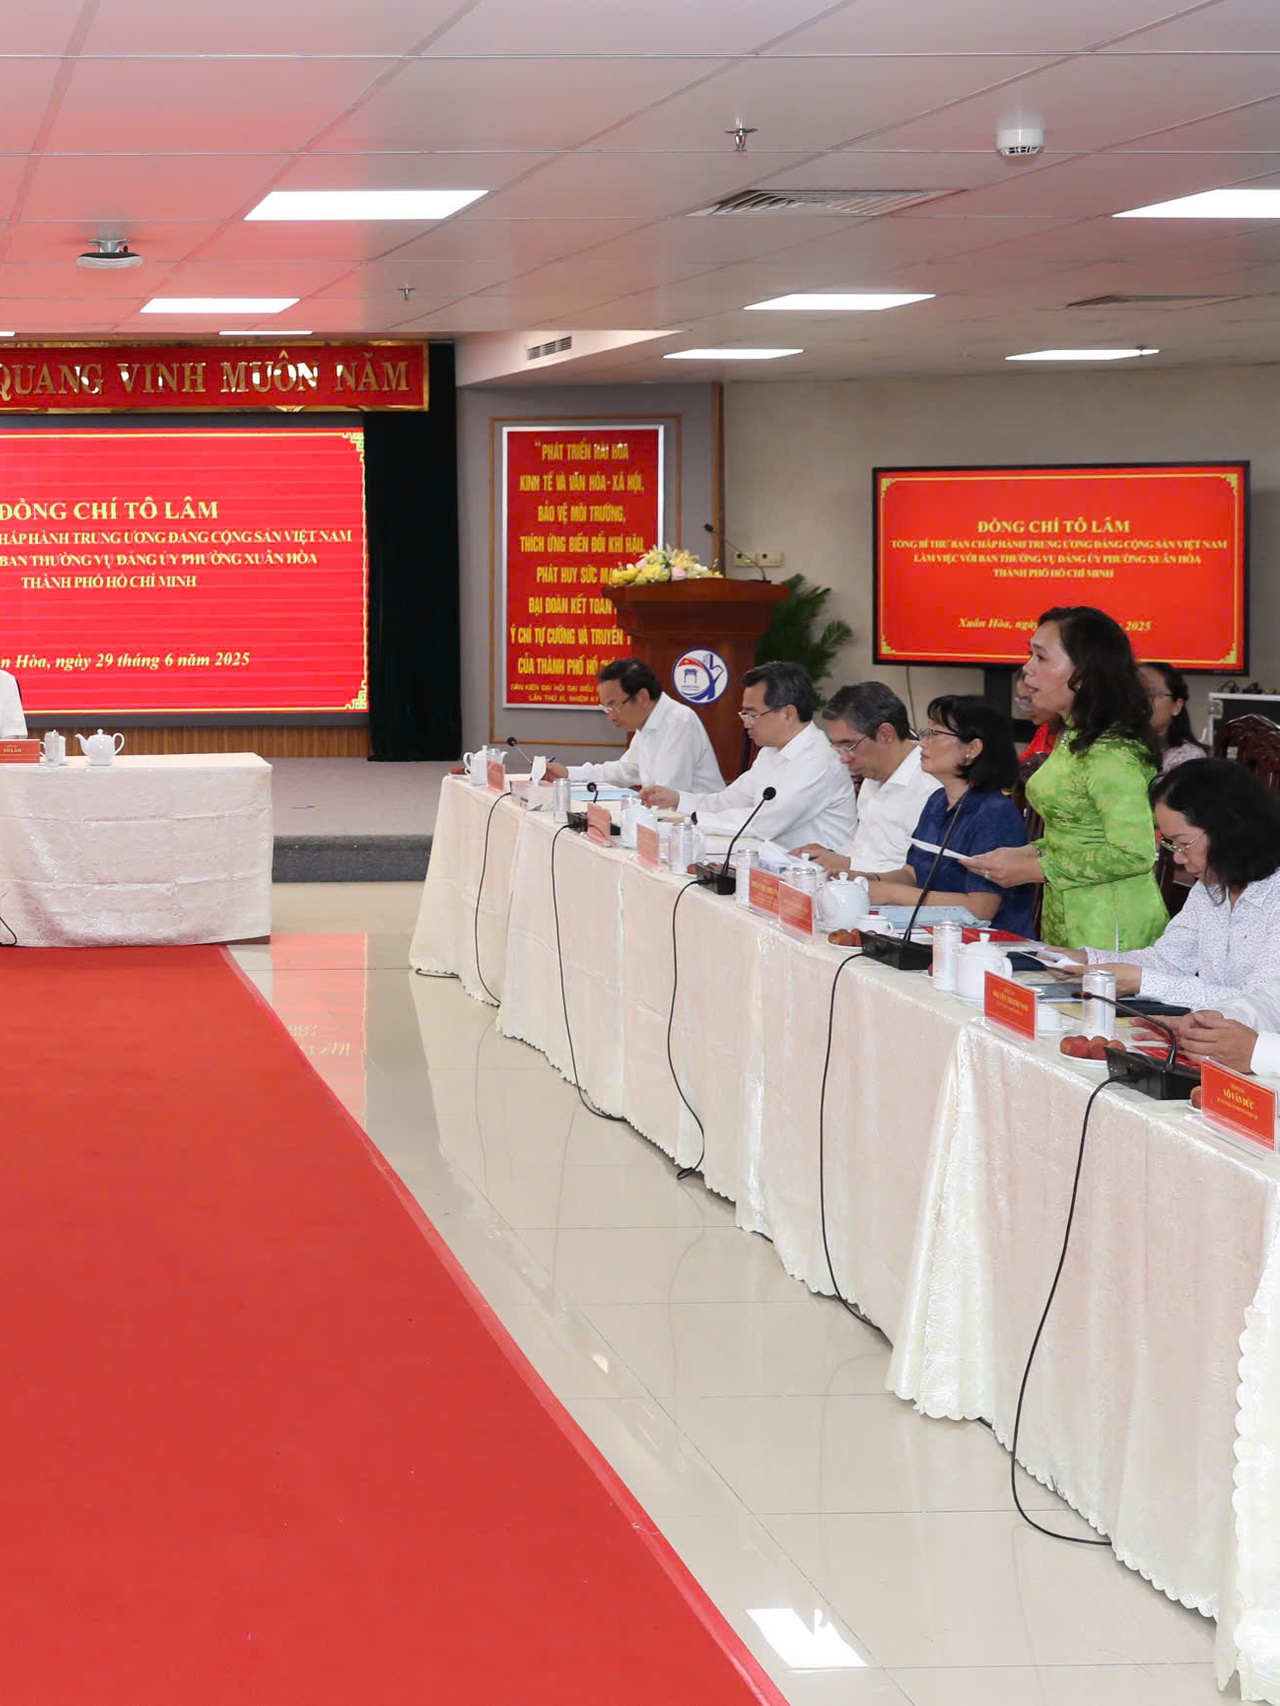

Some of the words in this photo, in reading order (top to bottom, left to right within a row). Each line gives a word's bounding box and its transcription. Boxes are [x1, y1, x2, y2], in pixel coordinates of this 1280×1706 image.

[117, 363, 206, 393] VINH
[220, 349, 320, 393] MUÔN
[335, 351, 409, 392] NĂM
[73, 497, 117, 520] CHÍ
[124, 496, 158, 520] TÔ
[164, 496, 218, 519] LÂM
[978, 517, 1025, 533] ĐỒNG
[1029, 517, 1059, 533] CHÍ
[1063, 516, 1088, 533] TÔ
[1091, 516, 1130, 533] LÂM
[28, 530, 69, 544] HÀNH
[72, 531, 120, 544] TRUNG
[124, 530, 166, 544] ƯƠNG
[168, 528, 209, 543] ĐẢNG
[210, 529, 252, 545] CỘNG
[254, 528, 282, 543] SẢN
[284, 529, 317, 545] VIỆT
[319, 529, 352, 542] NAM
[29, 552, 92, 566] THƯỜNG
[94, 554, 114, 569] VỤ
[117, 551, 157, 566] ĐẢNG
[159, 550, 179, 565] ỦY
[181, 550, 243, 565] PHƯỜNG
[245, 549, 285, 564] XUÂN
[287, 549, 317, 564] HÒA
[21, 573, 71, 589] THÀNH
[74, 573, 104, 588] PHỐ
[106, 573, 128, 588] HỒ
[130, 572, 156, 588] CHÍ
[158, 575, 197, 588] MINH
[537, 564, 558, 583] PHÁT
[561, 567, 578, 583] HUY
[580, 564, 597, 583] SỨC
[15, 653, 51, 670] Hòa,
[55, 654, 91, 671] ngày
[95, 653, 113, 667] 29
[117, 652, 160, 670] tháng
[164, 652, 174, 667] 6
[177, 653, 210, 667] năm
[214, 651, 251, 667] 2025
[518, 652, 534, 674] CỦA
[536, 655, 564, 674] THÀNH
[566, 654, 585, 674] PHỐ
